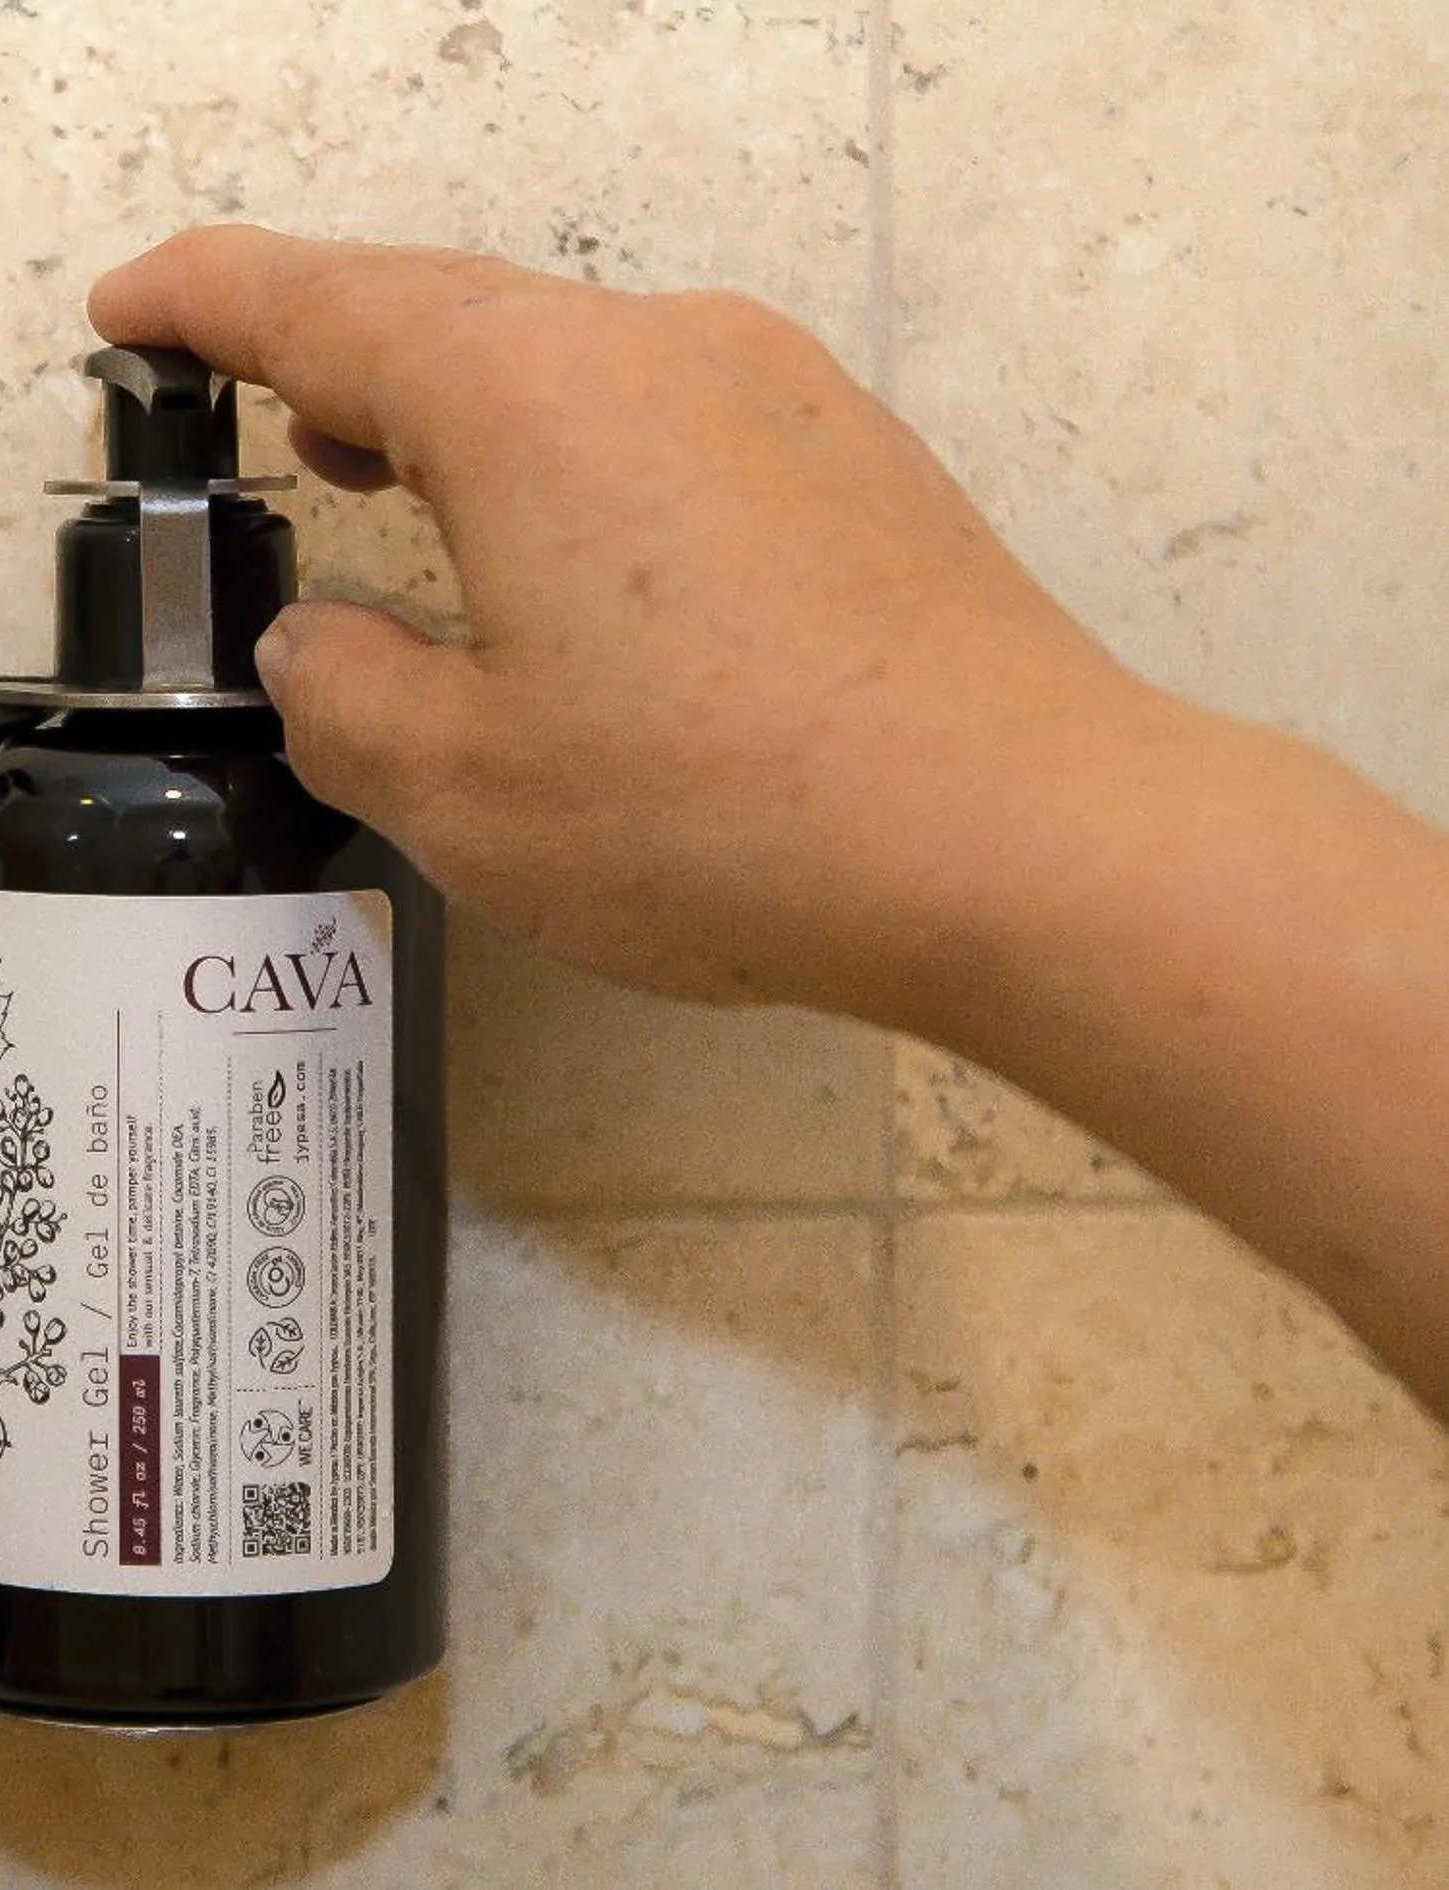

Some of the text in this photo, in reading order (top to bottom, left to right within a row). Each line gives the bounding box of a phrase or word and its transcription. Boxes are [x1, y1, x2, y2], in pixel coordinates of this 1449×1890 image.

[183, 950, 373, 1014] CAVA
[246, 1081, 263, 1153] Paraben
[293, 1061, 309, 1164] jypesa.com
[126, 1114, 138, 1164] yourself
[256, 1111, 282, 1164] free
[128, 1167, 138, 1210] pamper
[126, 1246, 137, 1289] shower
[142, 1251, 153, 1295] sensual
[80, 1084, 112, 1558] Shower Gel / Gel de baño
[126, 1293, 137, 1312] the
[144, 1299, 152, 1319] our
[126, 1315, 138, 1348] Enjoy
[142, 1323, 152, 1348] with
[131, 1378, 150, 1556] 8.45 fl oz / 250 ml
[298, 1443, 313, 1467] WE
